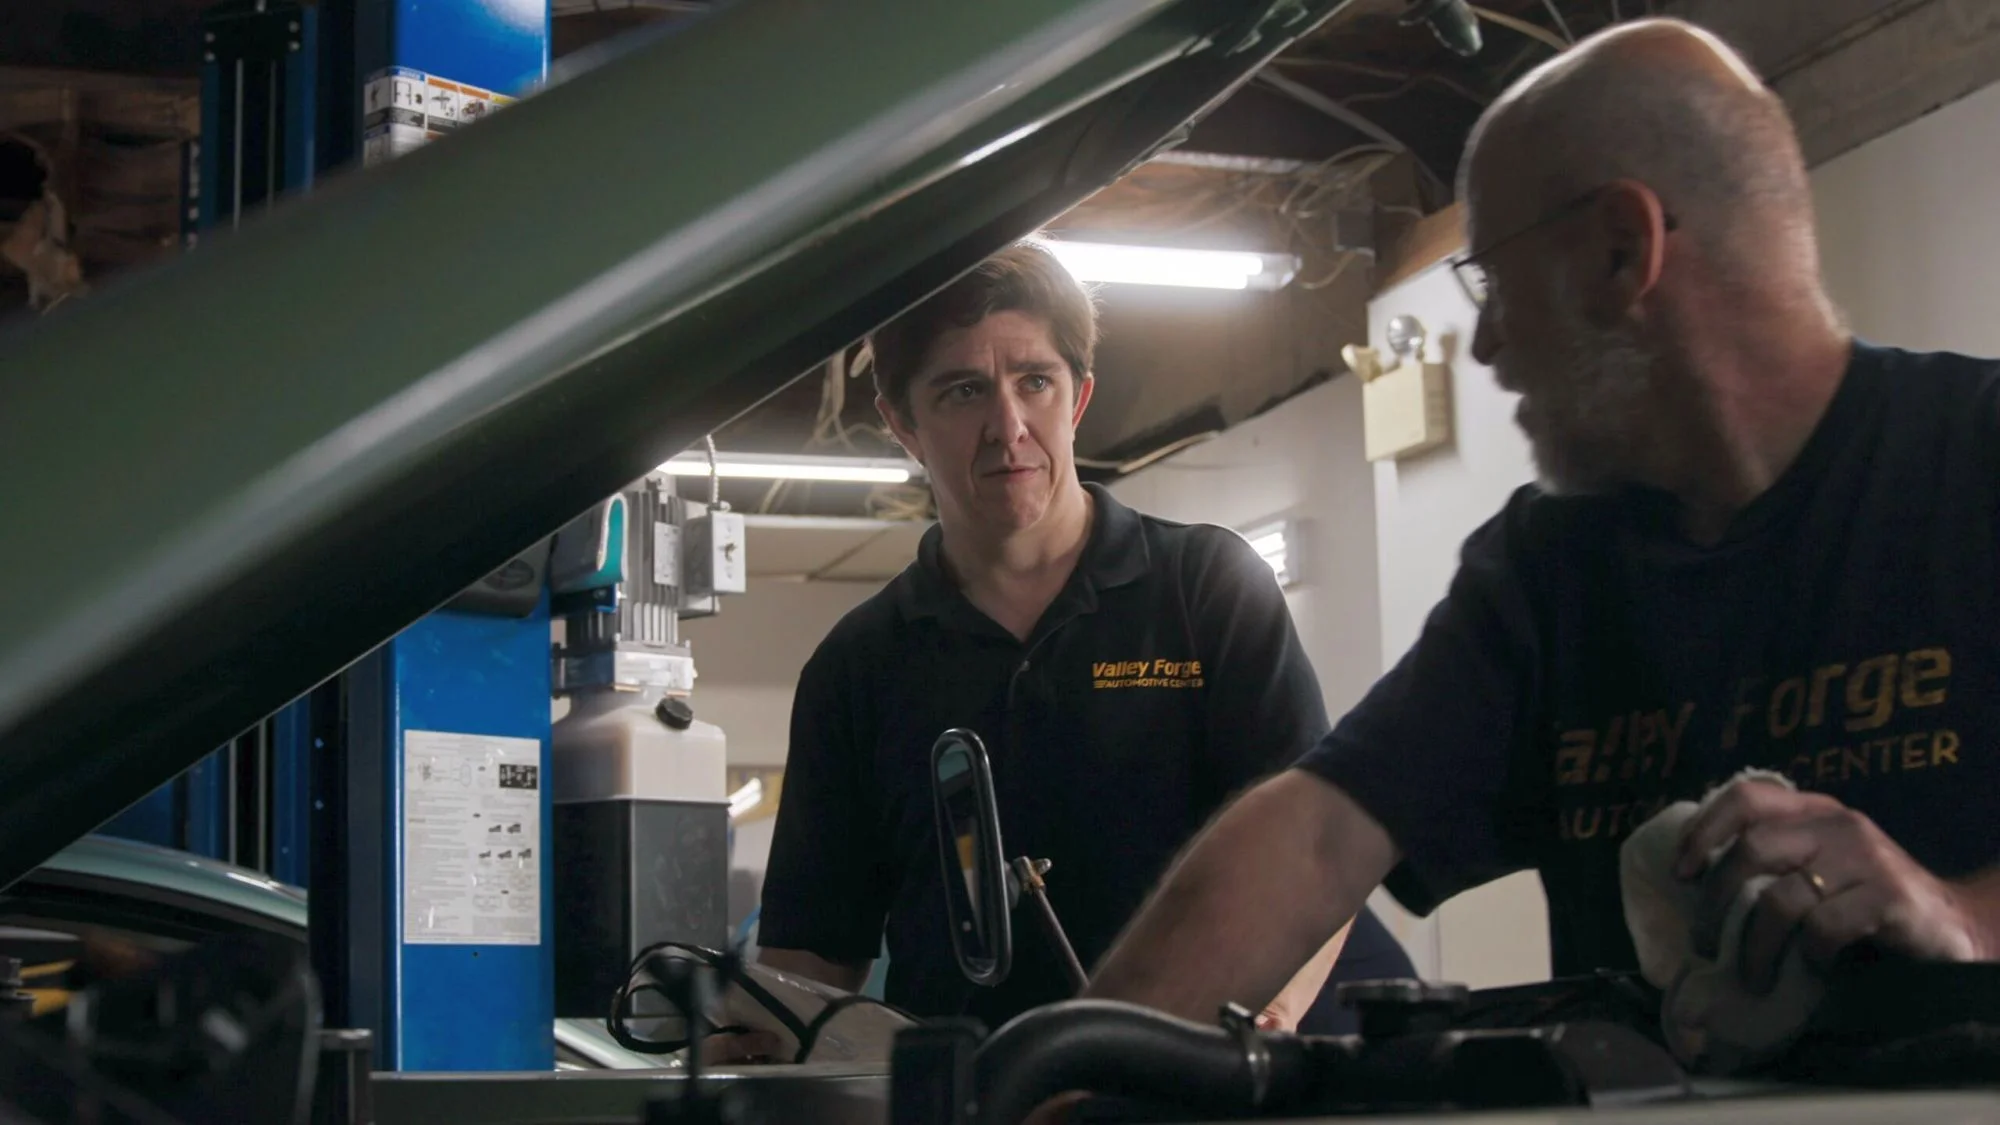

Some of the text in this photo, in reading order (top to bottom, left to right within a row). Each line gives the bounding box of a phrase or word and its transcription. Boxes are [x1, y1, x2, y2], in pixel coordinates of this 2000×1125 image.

[1092, 659, 1201, 678] Valley Forge
[1104, 678, 1168, 688] AUTOMOTIVE
[1555, 702, 1696, 786] alley
[1789, 728, 1960, 789] CENTER
